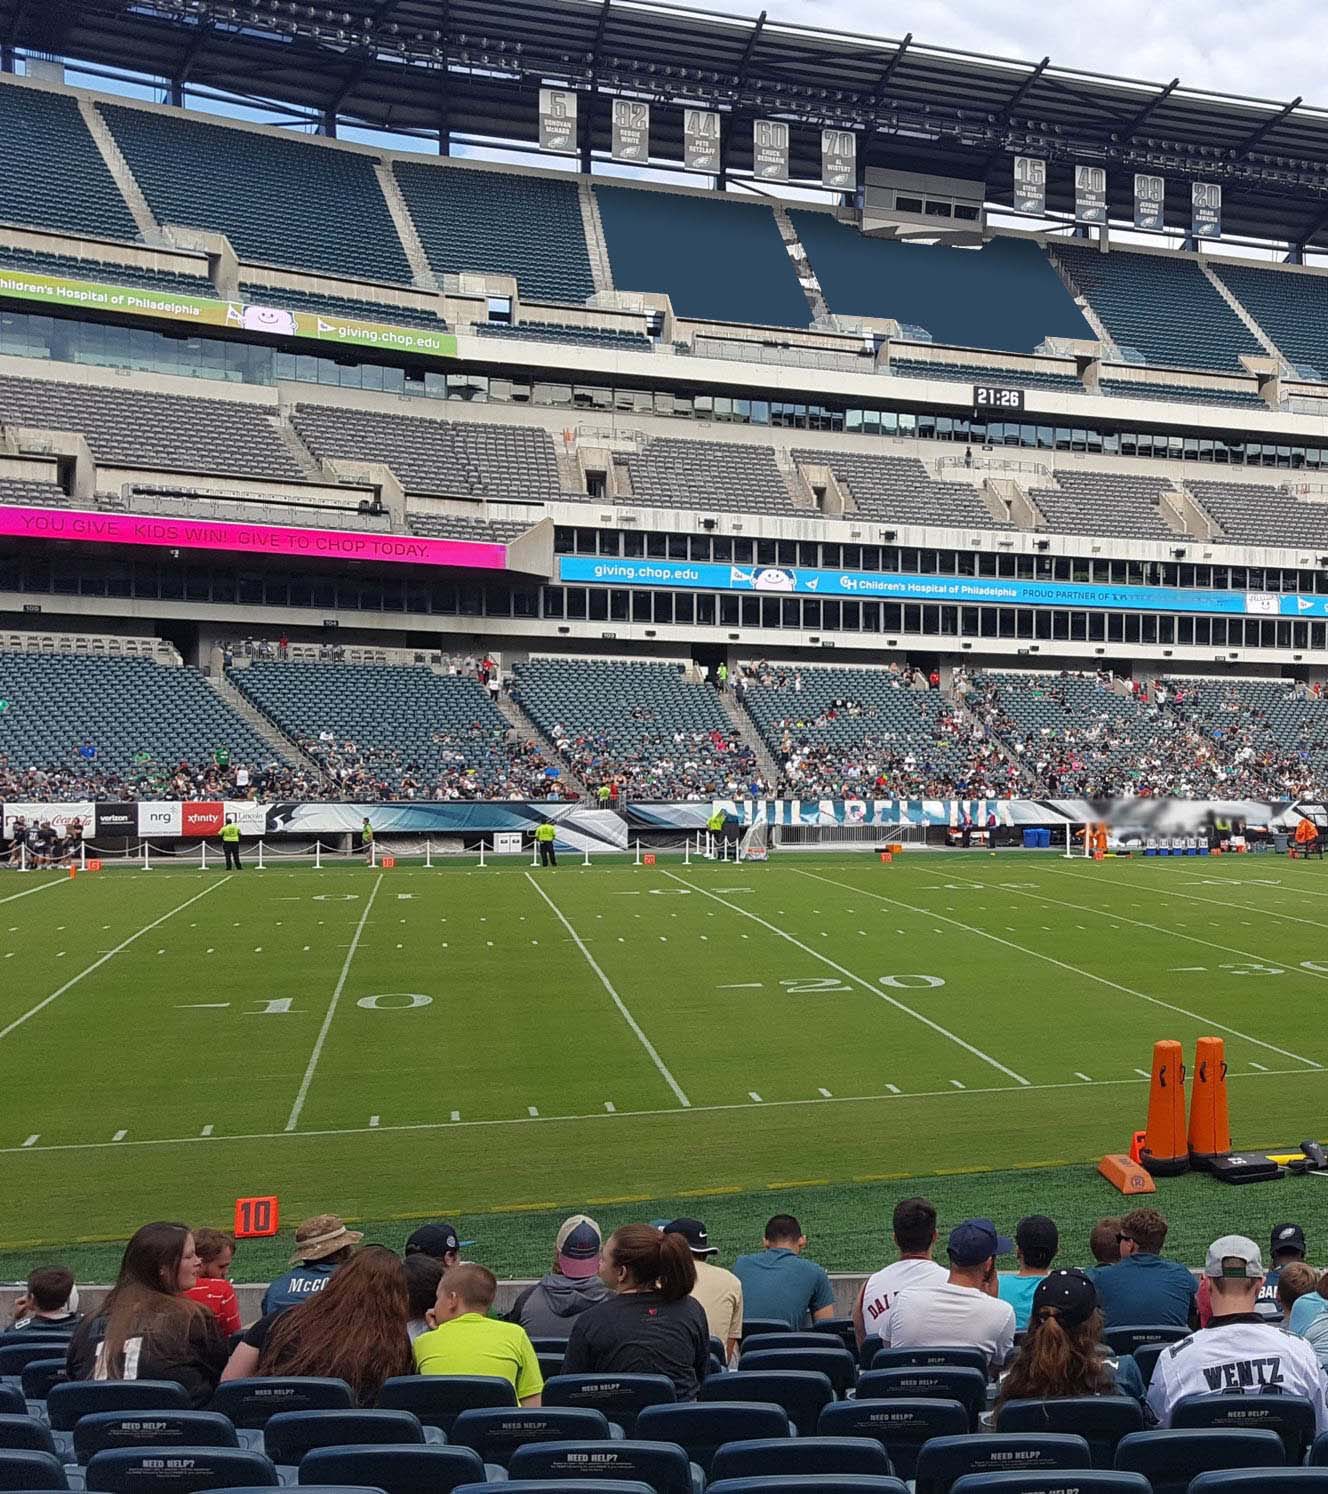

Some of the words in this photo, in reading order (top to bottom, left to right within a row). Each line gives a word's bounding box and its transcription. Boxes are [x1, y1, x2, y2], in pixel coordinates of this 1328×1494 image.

[551, 92, 567, 118] 5
[615, 101, 646, 130] 92
[687, 111, 717, 139] 44
[756, 121, 786, 149] 60
[824, 131, 853, 158] 70
[1017, 159, 1043, 184] 15
[1078, 167, 1104, 193] 40
[1194, 184, 1220, 209] 20
[56, 287, 108, 304] Hospital
[112, 295, 125, 305] of
[128, 297, 201, 317] Philadelphia
[338, 326, 440, 349] giving.chop.edu
[977, 388, 1019, 407] 21:26
[21, 515, 65, 532] YOU
[134, 524, 178, 540] KIDS
[184, 526, 227, 544] WIN!
[238, 532, 280, 547] GIVE
[287, 535, 309, 549] TO
[316, 538, 365, 553] CHOP
[371, 542, 430, 559] TODAY.
[594, 564, 699, 581] giving.chop.edu
[859, 580, 906, 592] Children's
[908, 583, 948, 595] Hospital
[949, 584, 958, 593] of
[961, 585, 1017, 598] Philadelphia
[1022, 589, 1054, 599] PROUD
[1055, 590, 1097, 601] PARTNER
[1097, 592, 1111, 601] OF
[150, 812, 171, 824] nrg
[187, 814, 218, 823] xfinity
[241, 1200, 271, 1232] 10
[1203, 1357, 1284, 1391] WENTZ
[142, 1460, 165, 1468] NEED
[166, 1460, 195, 1468] HELP?
[567, 1454, 588, 1462] NEED
[591, 1454, 618, 1462] HELP?
[991, 1452, 1013, 1460] NEED
[1015, 1451, 1041, 1459] HELP?
